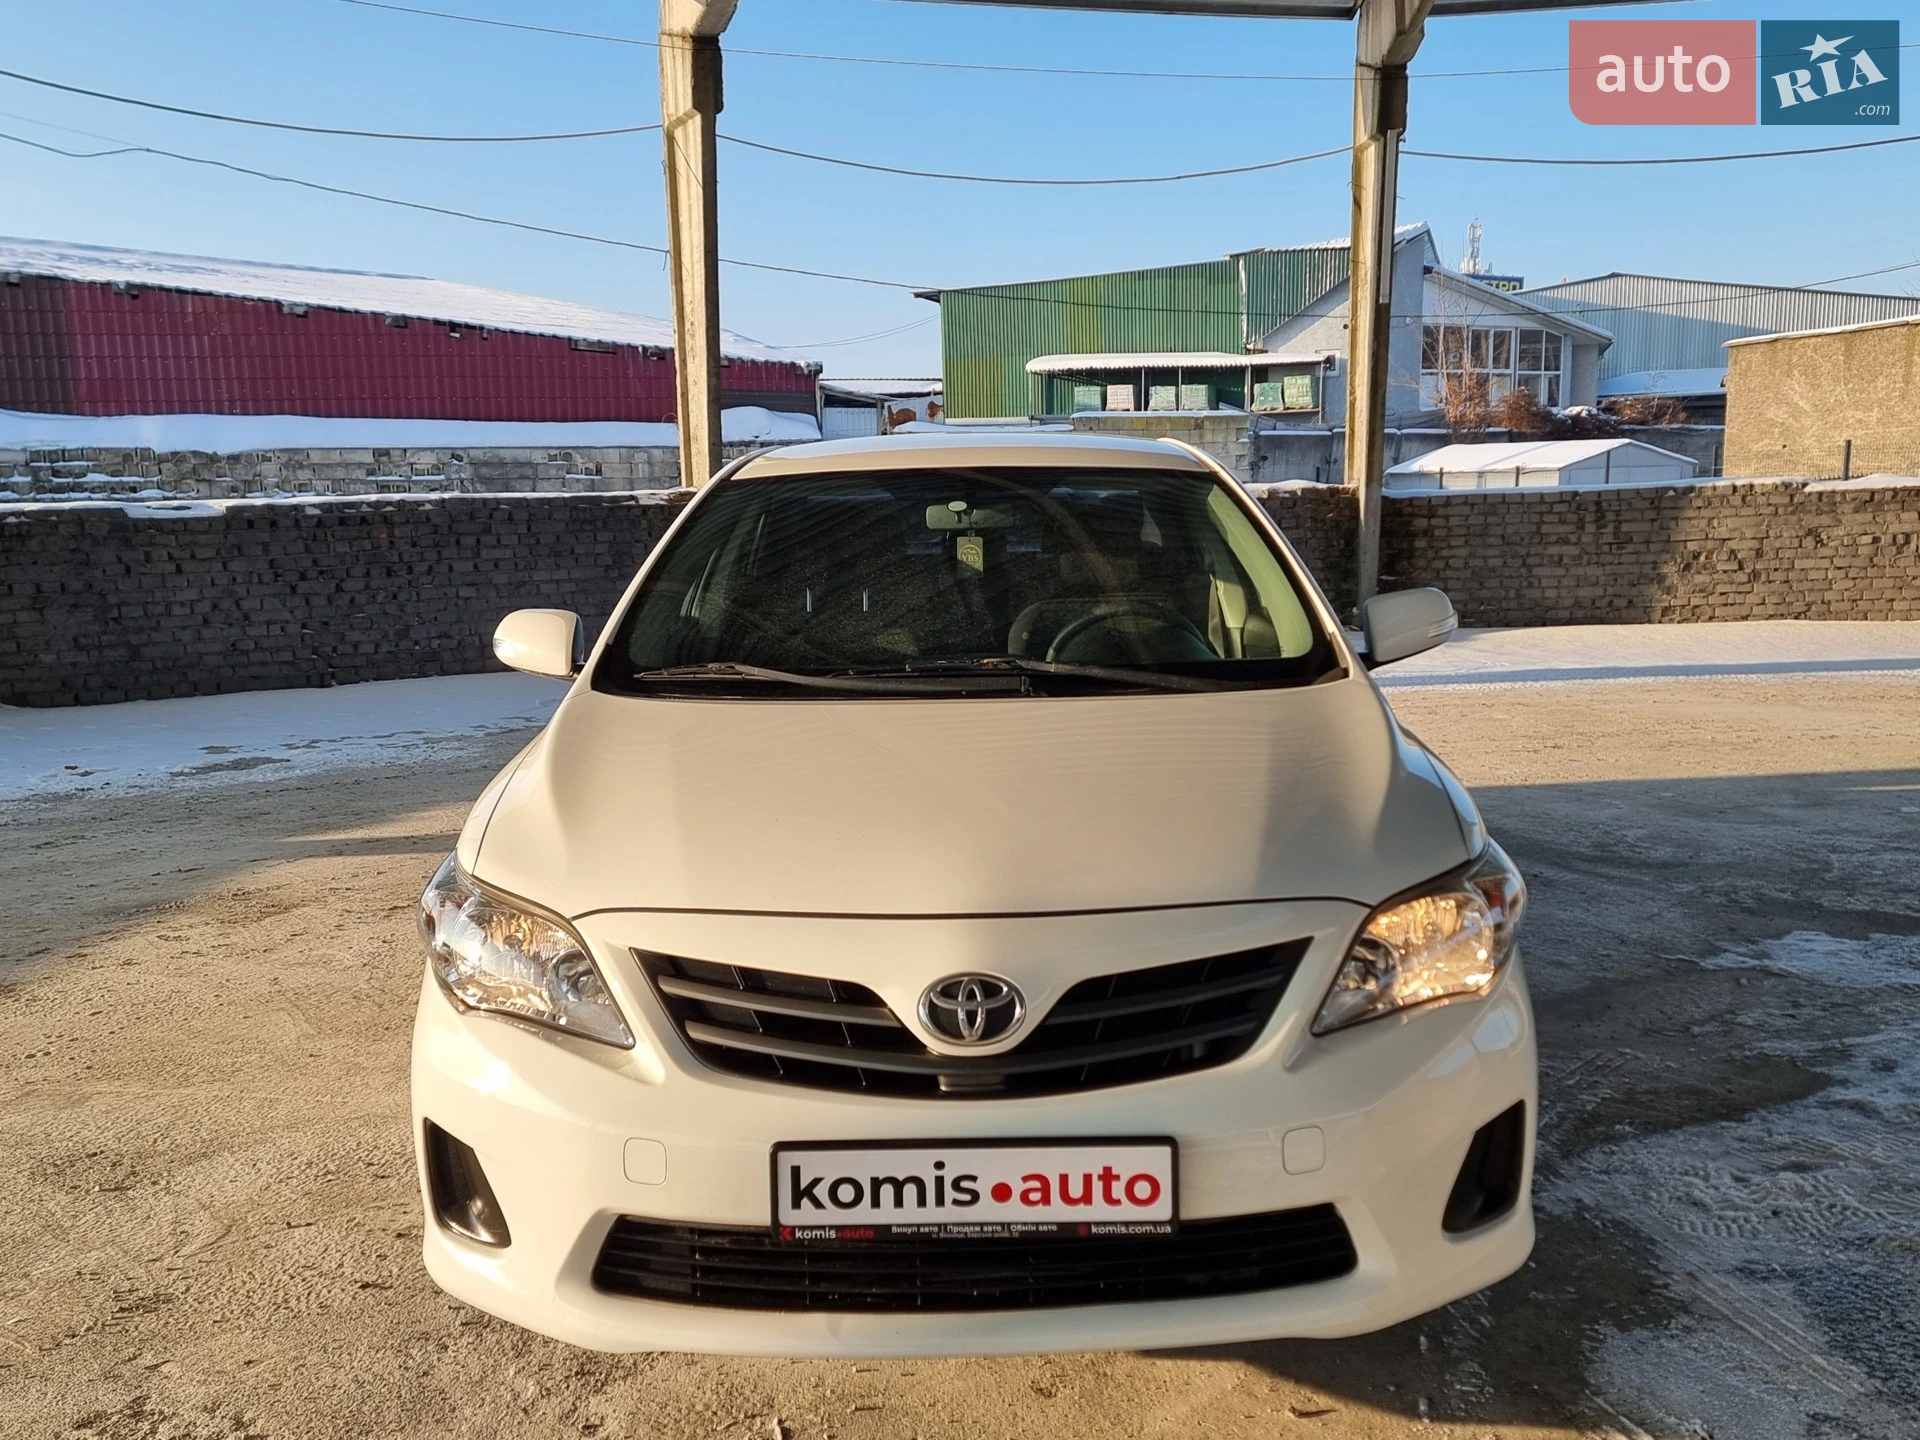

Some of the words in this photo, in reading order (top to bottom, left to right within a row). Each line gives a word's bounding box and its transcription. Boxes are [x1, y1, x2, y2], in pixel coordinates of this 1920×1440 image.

[891, 1225, 918, 1235] Викуп
[947, 1224, 982, 1234] Продаж
[1091, 1223, 1172, 1235] komis.com.ua
